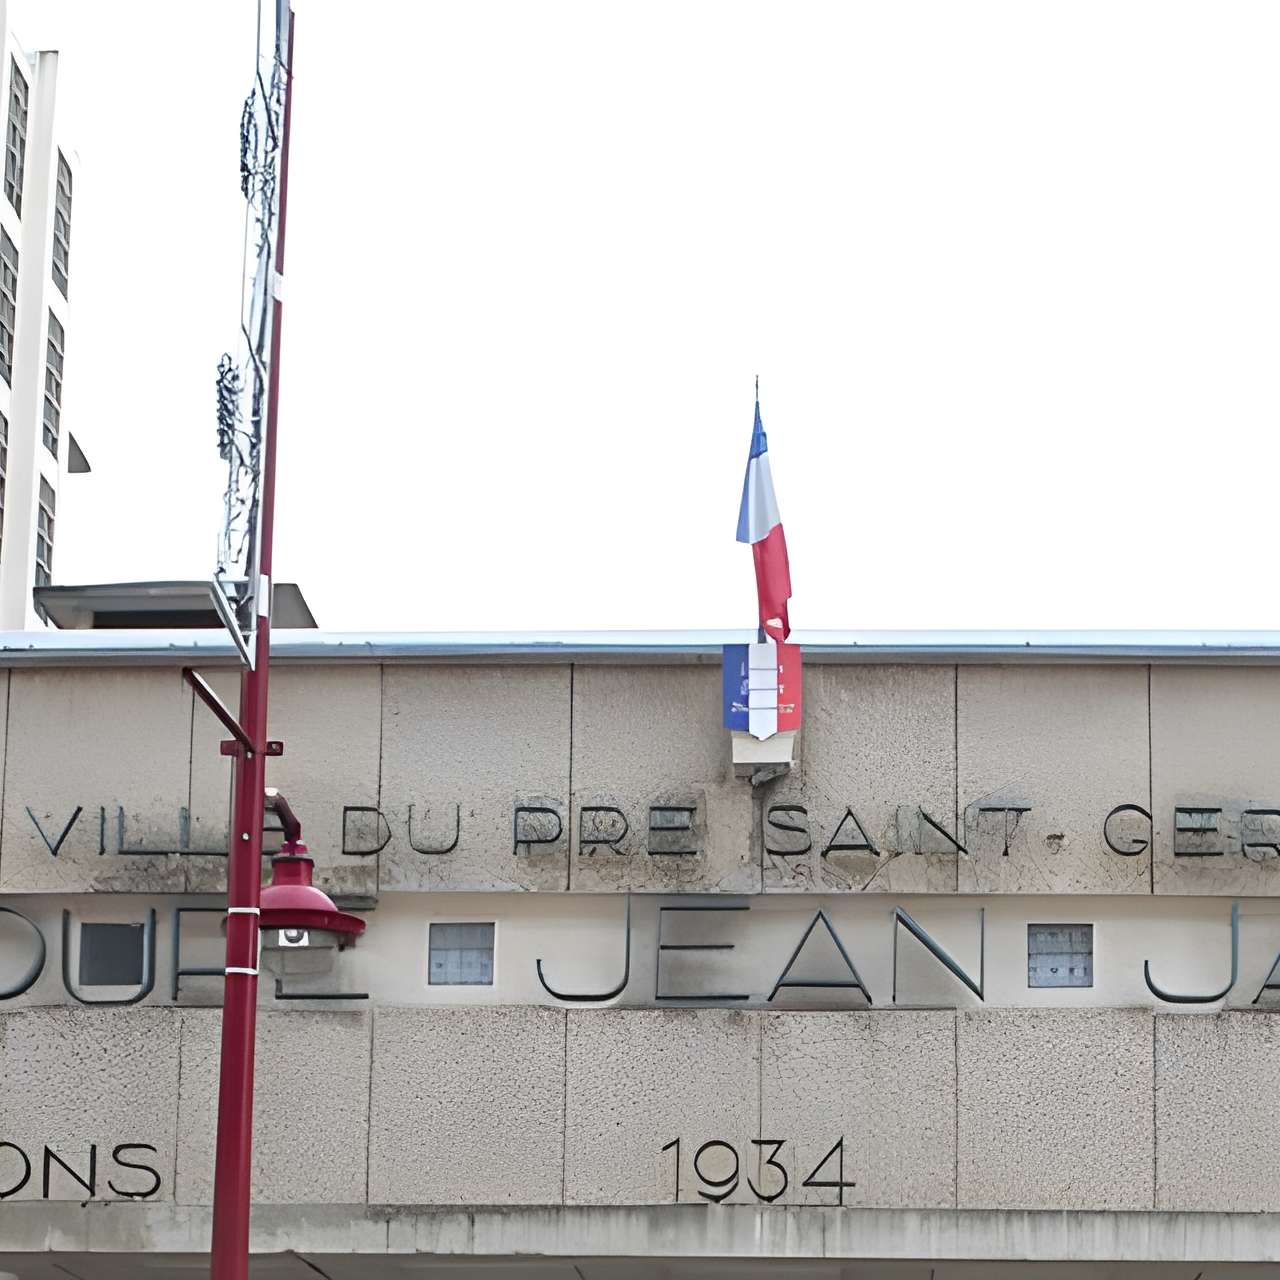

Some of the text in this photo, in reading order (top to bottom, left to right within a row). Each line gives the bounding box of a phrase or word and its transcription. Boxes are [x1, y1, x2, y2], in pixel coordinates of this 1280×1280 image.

[342, 803, 461, 855] DU
[513, 804, 698, 856] PRE
[535, 893, 985, 1005] JEAN
[662, 1134, 856, 1206] 1934
